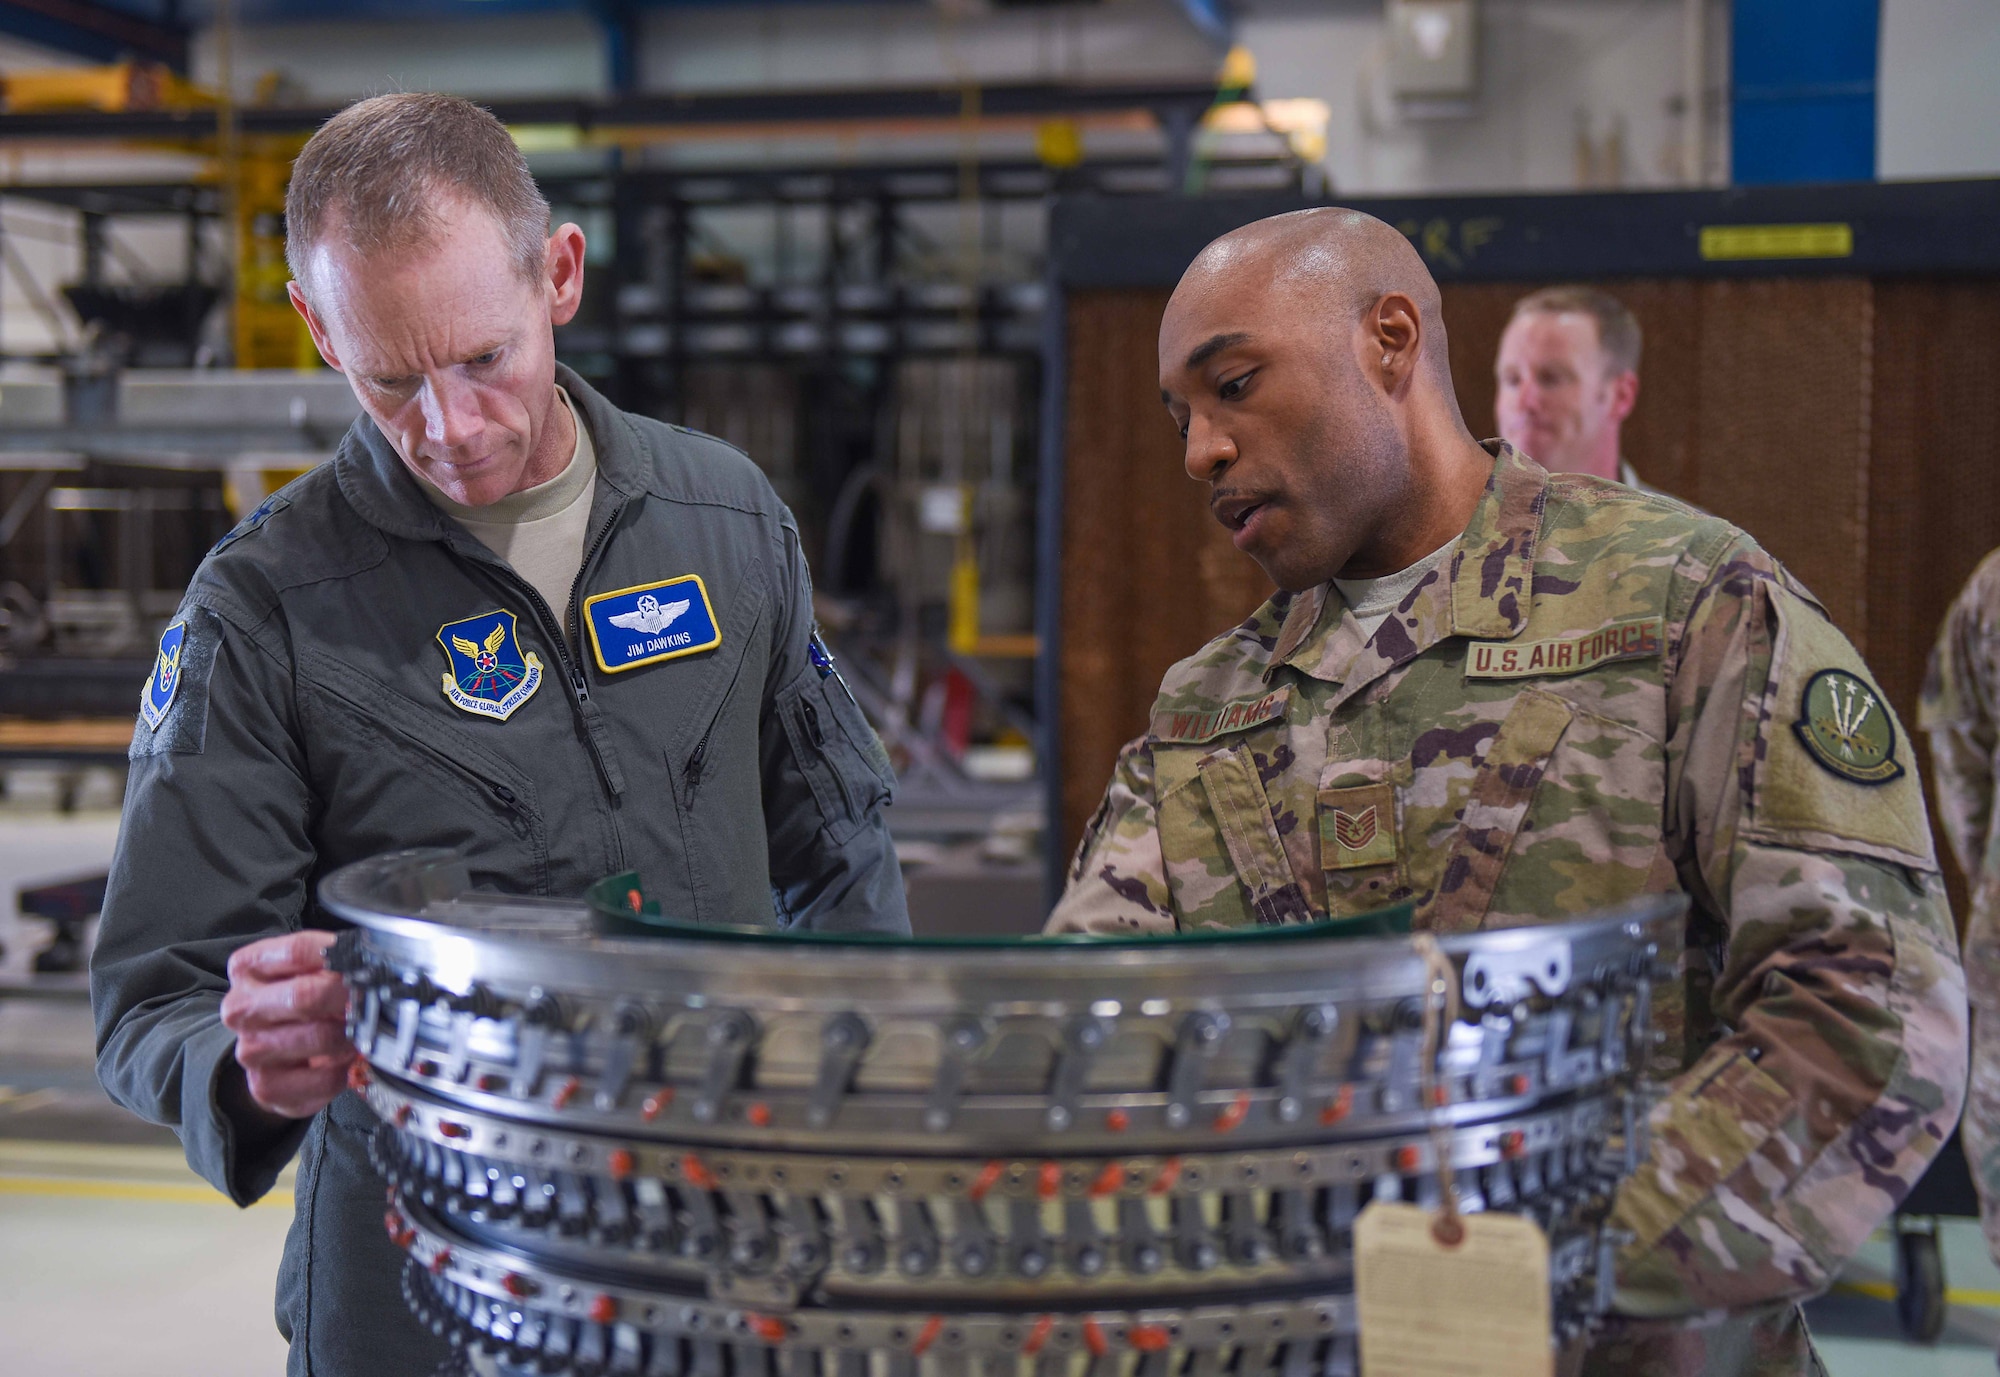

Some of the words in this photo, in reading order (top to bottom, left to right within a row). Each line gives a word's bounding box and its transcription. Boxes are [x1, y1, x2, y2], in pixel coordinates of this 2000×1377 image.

[626, 643, 646, 658] JIM
[647, 631, 692, 652] DAWKINS
[1475, 647, 1524, 673] U.S.
[1528, 643, 1574, 670] AIR
[1577, 622, 1657, 666] FORCE
[449, 688, 460, 702] AIR
[459, 696, 478, 710] FORCE
[478, 701, 504, 715] GLOBAL
[502, 691, 521, 714] STRIKE
[519, 667, 540, 697] COMMAND
[1169, 693, 1276, 740] WILLIAMS
